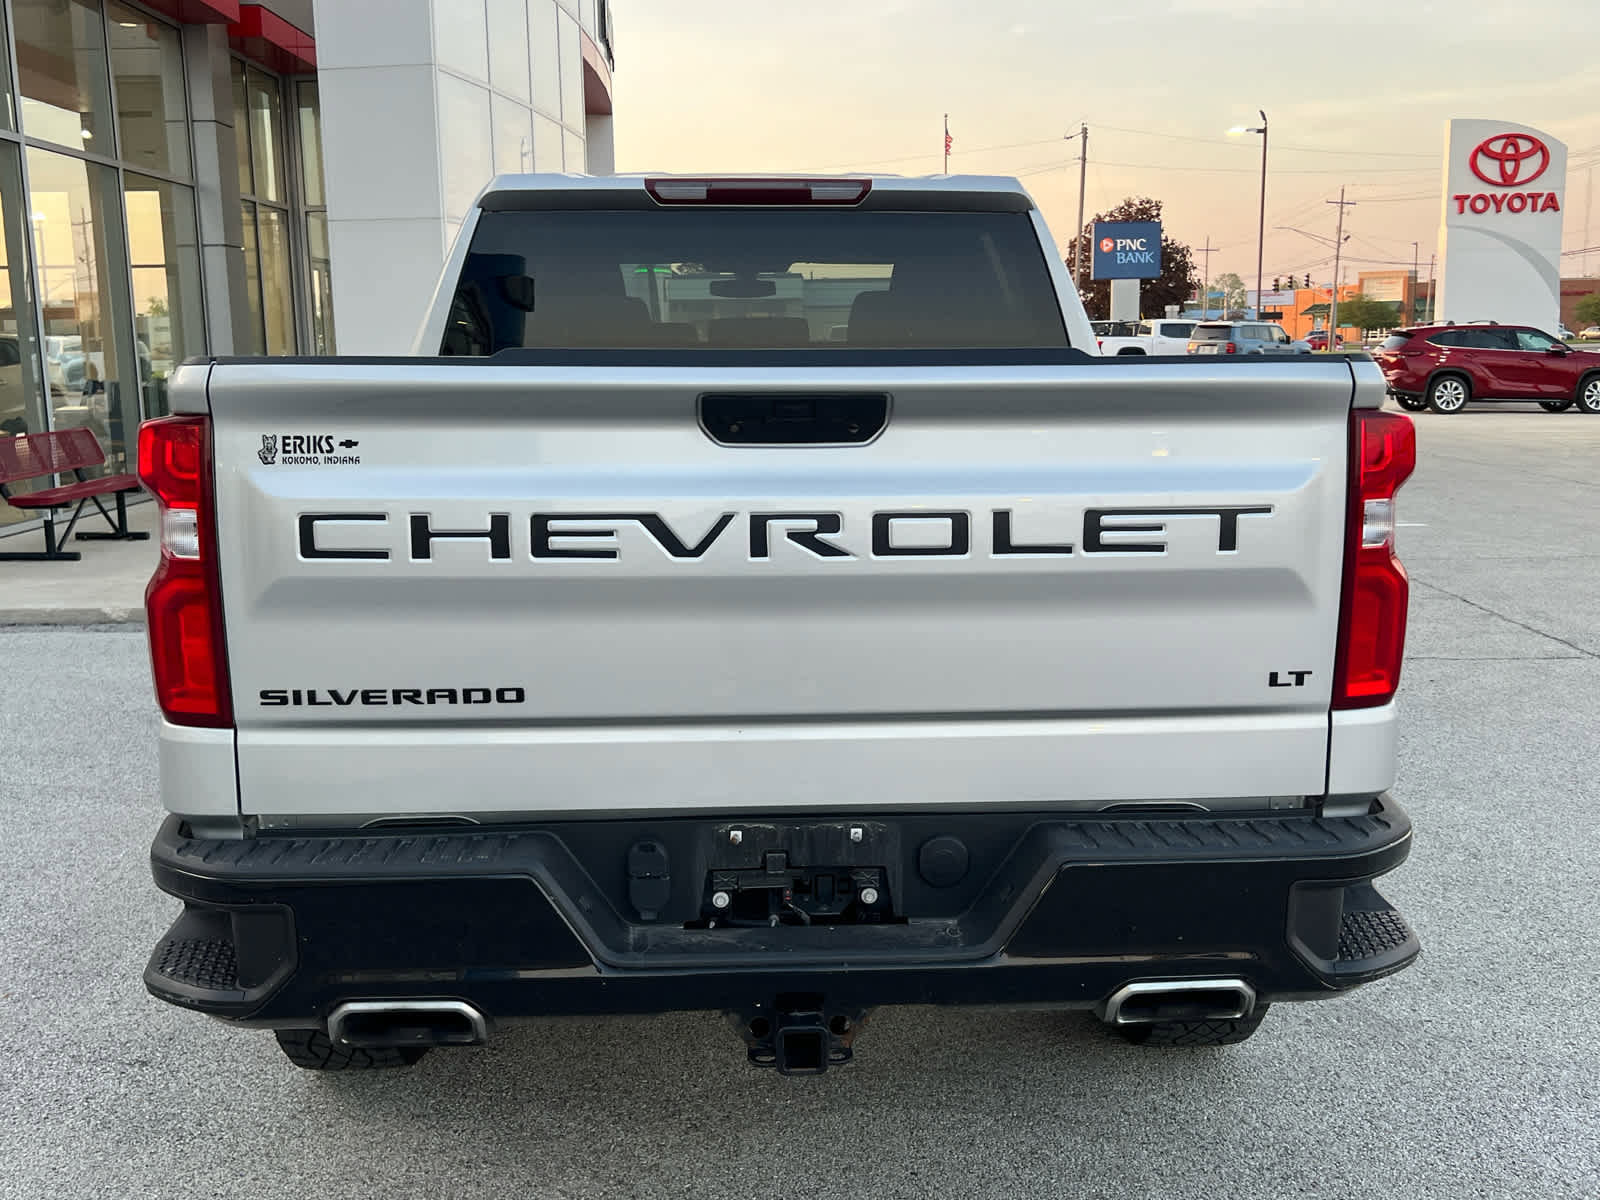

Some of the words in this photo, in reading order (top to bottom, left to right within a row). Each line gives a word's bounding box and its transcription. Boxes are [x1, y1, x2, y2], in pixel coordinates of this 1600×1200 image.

[1453, 192, 1560, 214] TOYOTA
[1116, 238, 1147, 251] PNC
[1116, 251, 1155, 264] BANK
[281, 435, 335, 454] ERIKS
[281, 456, 321, 465] KOKOMO,
[323, 455, 361, 465] INDIANA
[298, 505, 1273, 563] CHEVROLET
[1269, 670, 1313, 687] LT
[259, 687, 526, 706] SILVERADO
